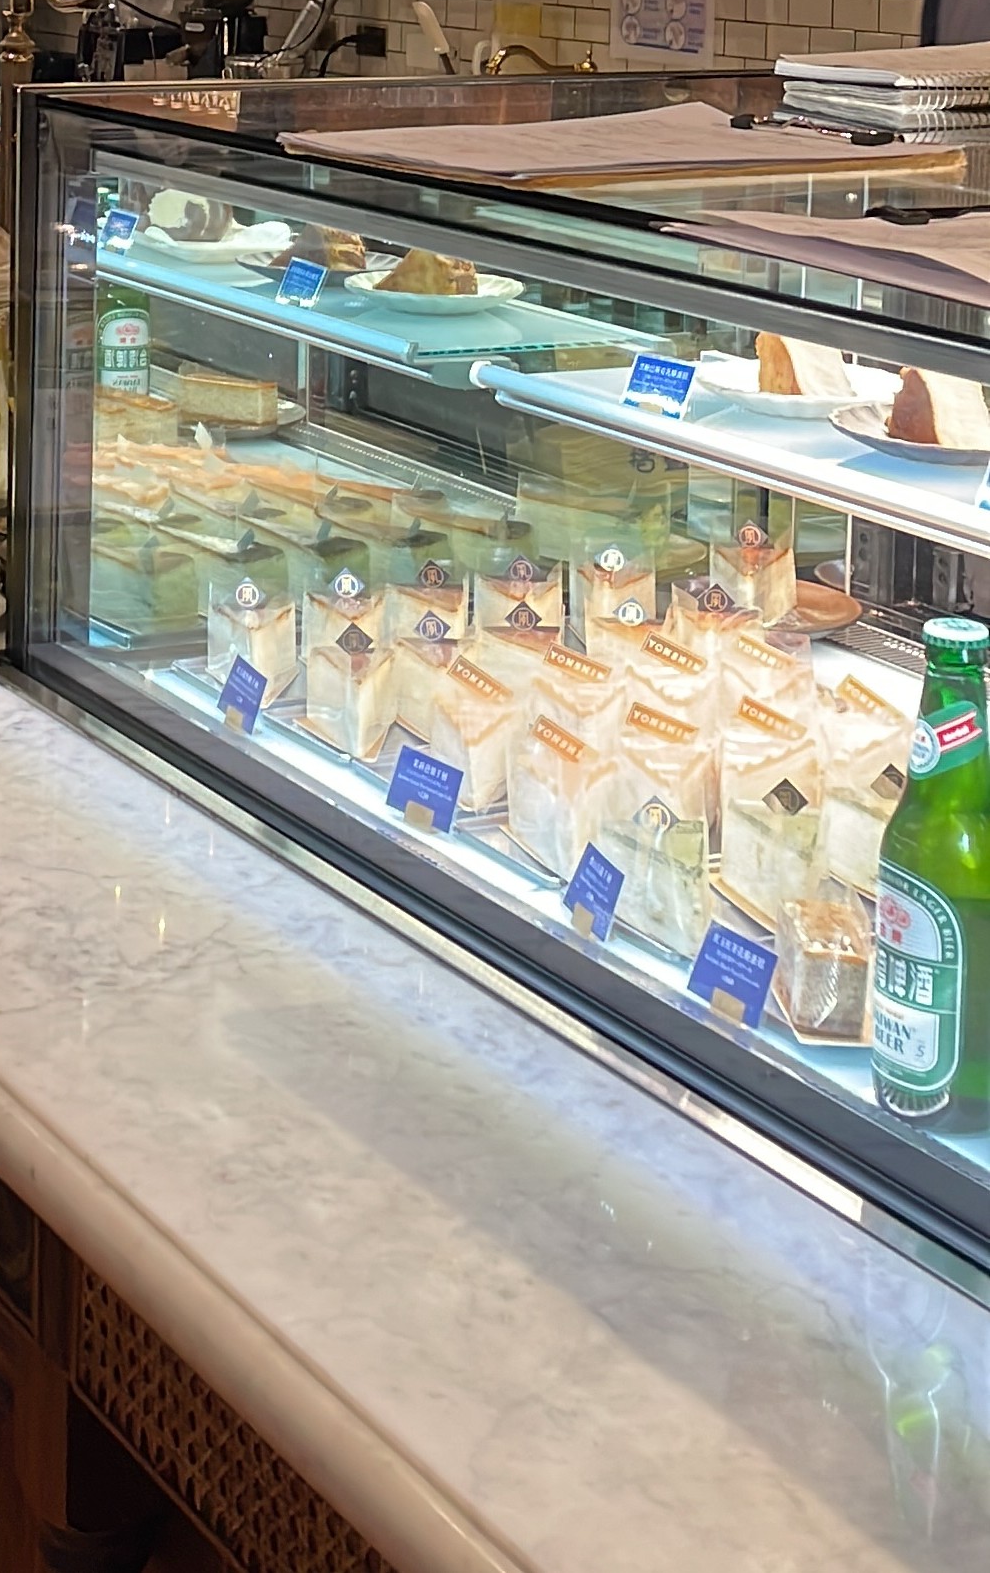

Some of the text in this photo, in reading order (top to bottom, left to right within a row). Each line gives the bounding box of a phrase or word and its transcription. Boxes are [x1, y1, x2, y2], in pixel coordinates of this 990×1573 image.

[549, 650, 606, 681] YONSHIN
[648, 638, 702, 673] YONSHIN
[535, 722, 584, 760] YONSHI
[633, 709, 692, 740] YONSHIN
[912, 887, 955, 960] LAGER BEER
